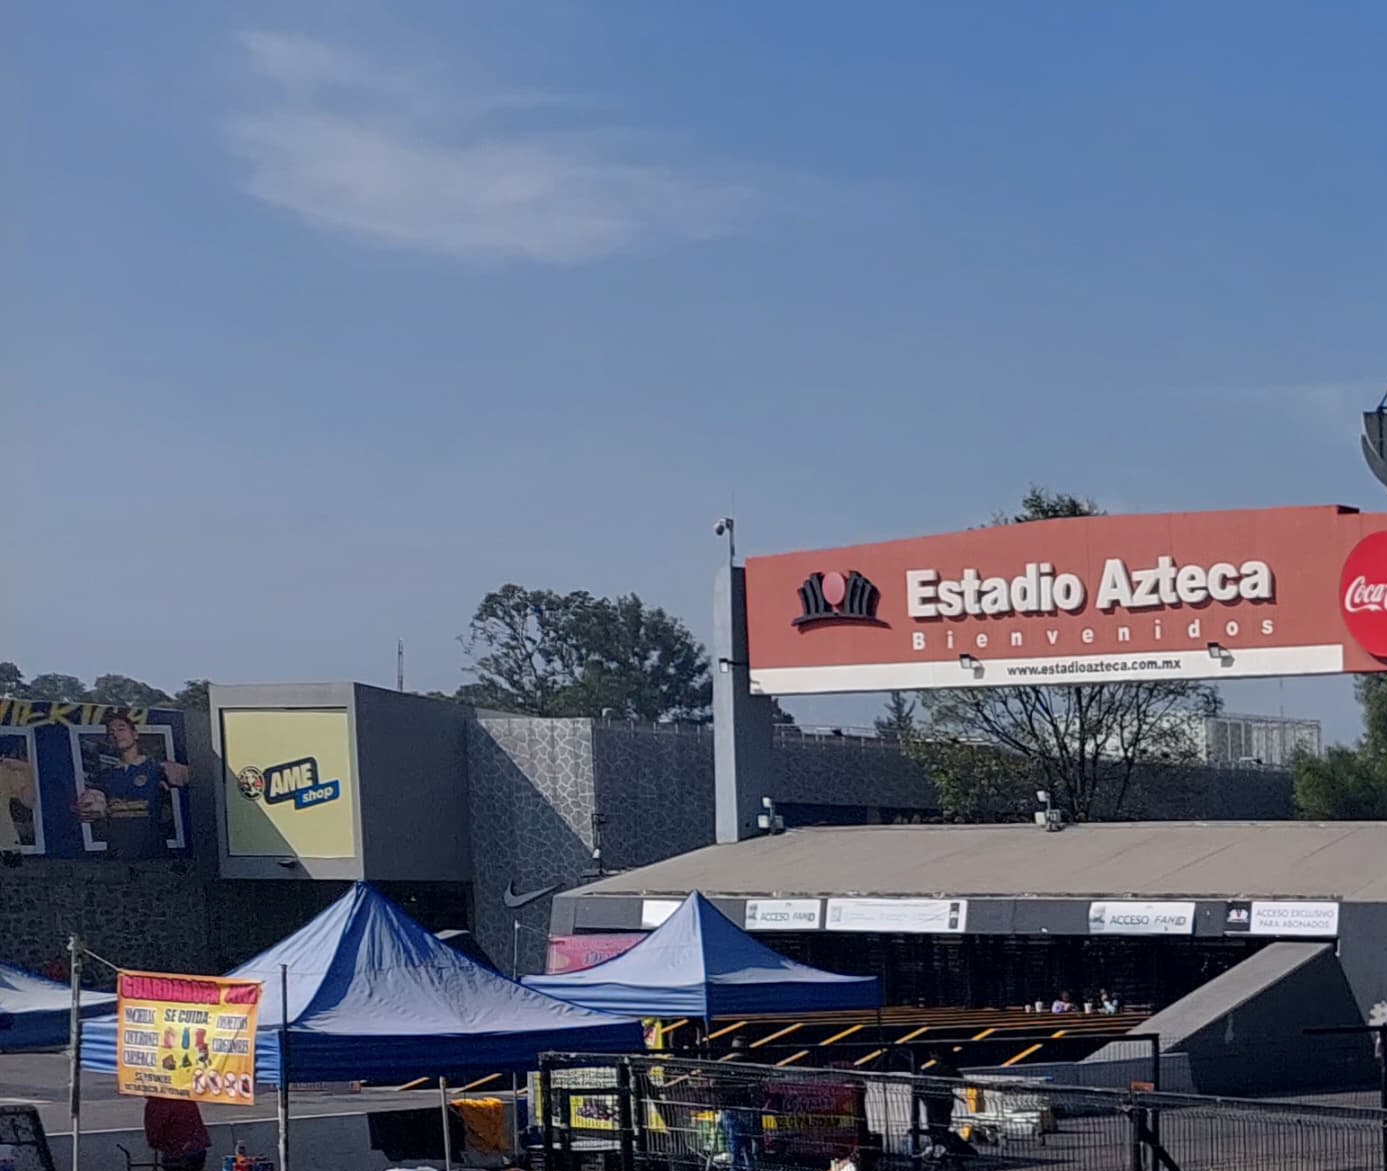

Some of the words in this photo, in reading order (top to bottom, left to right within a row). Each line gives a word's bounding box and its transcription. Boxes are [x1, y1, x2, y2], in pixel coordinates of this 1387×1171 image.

[905, 562, 1083, 618] Estadio
[1095, 556, 1275, 610] Azteca
[912, 618, 1273, 650] Bienvenidos
[1006, 657, 1182, 677] www.estadioazteca.com.mx
[269, 762, 313, 798] AME
[302, 786, 334, 803] shop
[760, 911, 790, 922] ACCESO
[1109, 914, 1149, 926] ACCESO
[1256, 908, 1288, 919] ACCESO
[1291, 908, 1334, 919] EXCLUSIVO
[1282, 919, 1331, 930] ABONADOS
